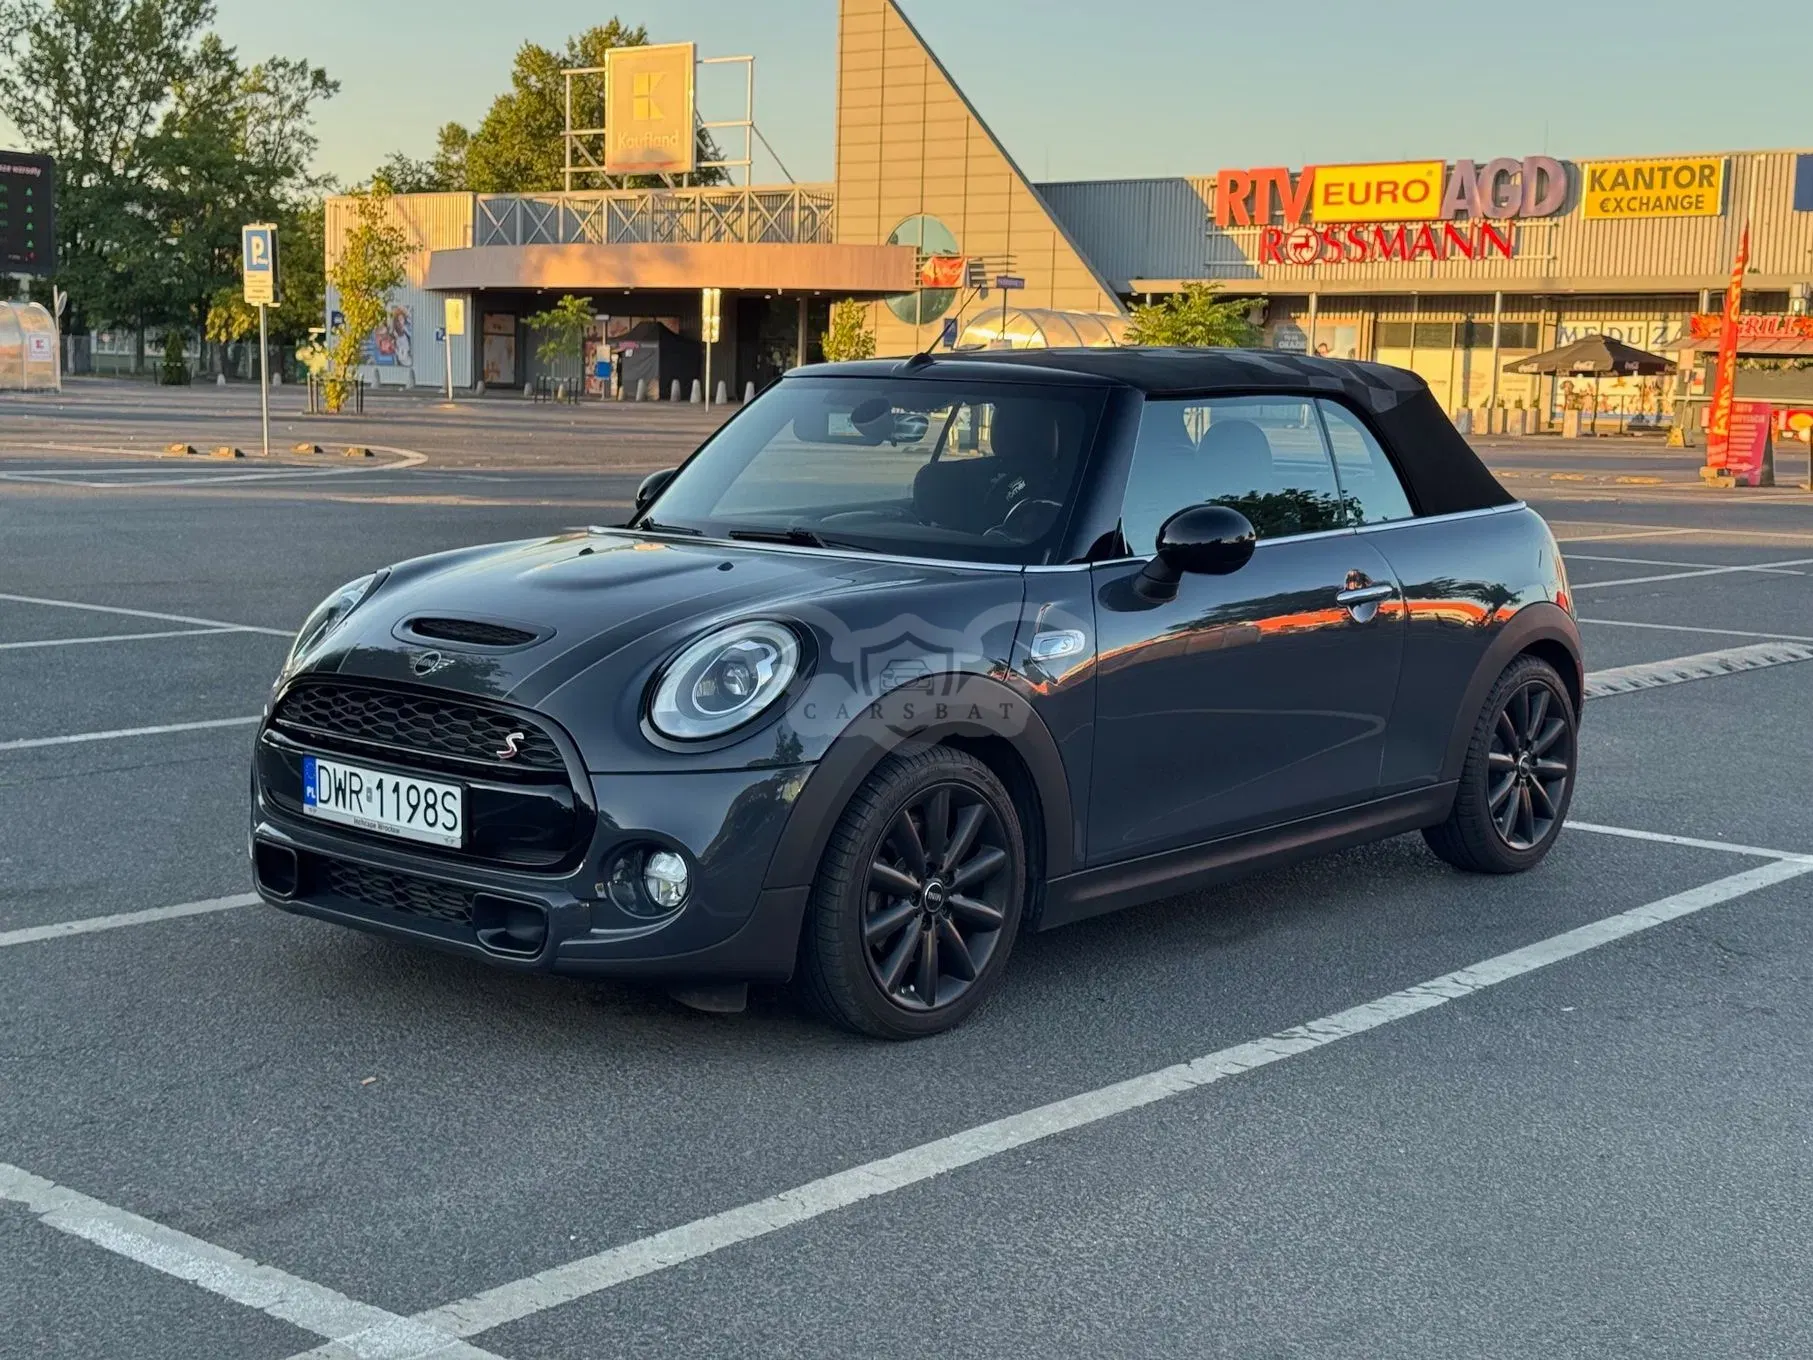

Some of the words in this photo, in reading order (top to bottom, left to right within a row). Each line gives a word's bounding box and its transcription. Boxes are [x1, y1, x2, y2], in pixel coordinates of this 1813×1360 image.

[618, 130, 680, 149] Kaufland
[1215, 166, 1316, 226] RTV
[1323, 178, 1430, 206] EURO
[1440, 156, 1568, 220] AGD
[1589, 163, 1717, 193] KANTOR
[251, 235, 265, 266] P
[1260, 222, 1515, 266] ROSSMANN
[496, 732, 525, 759] S
[306, 786, 316, 799] PL
[317, 765, 364, 813] DWR
[376, 777, 458, 832] 1198S
